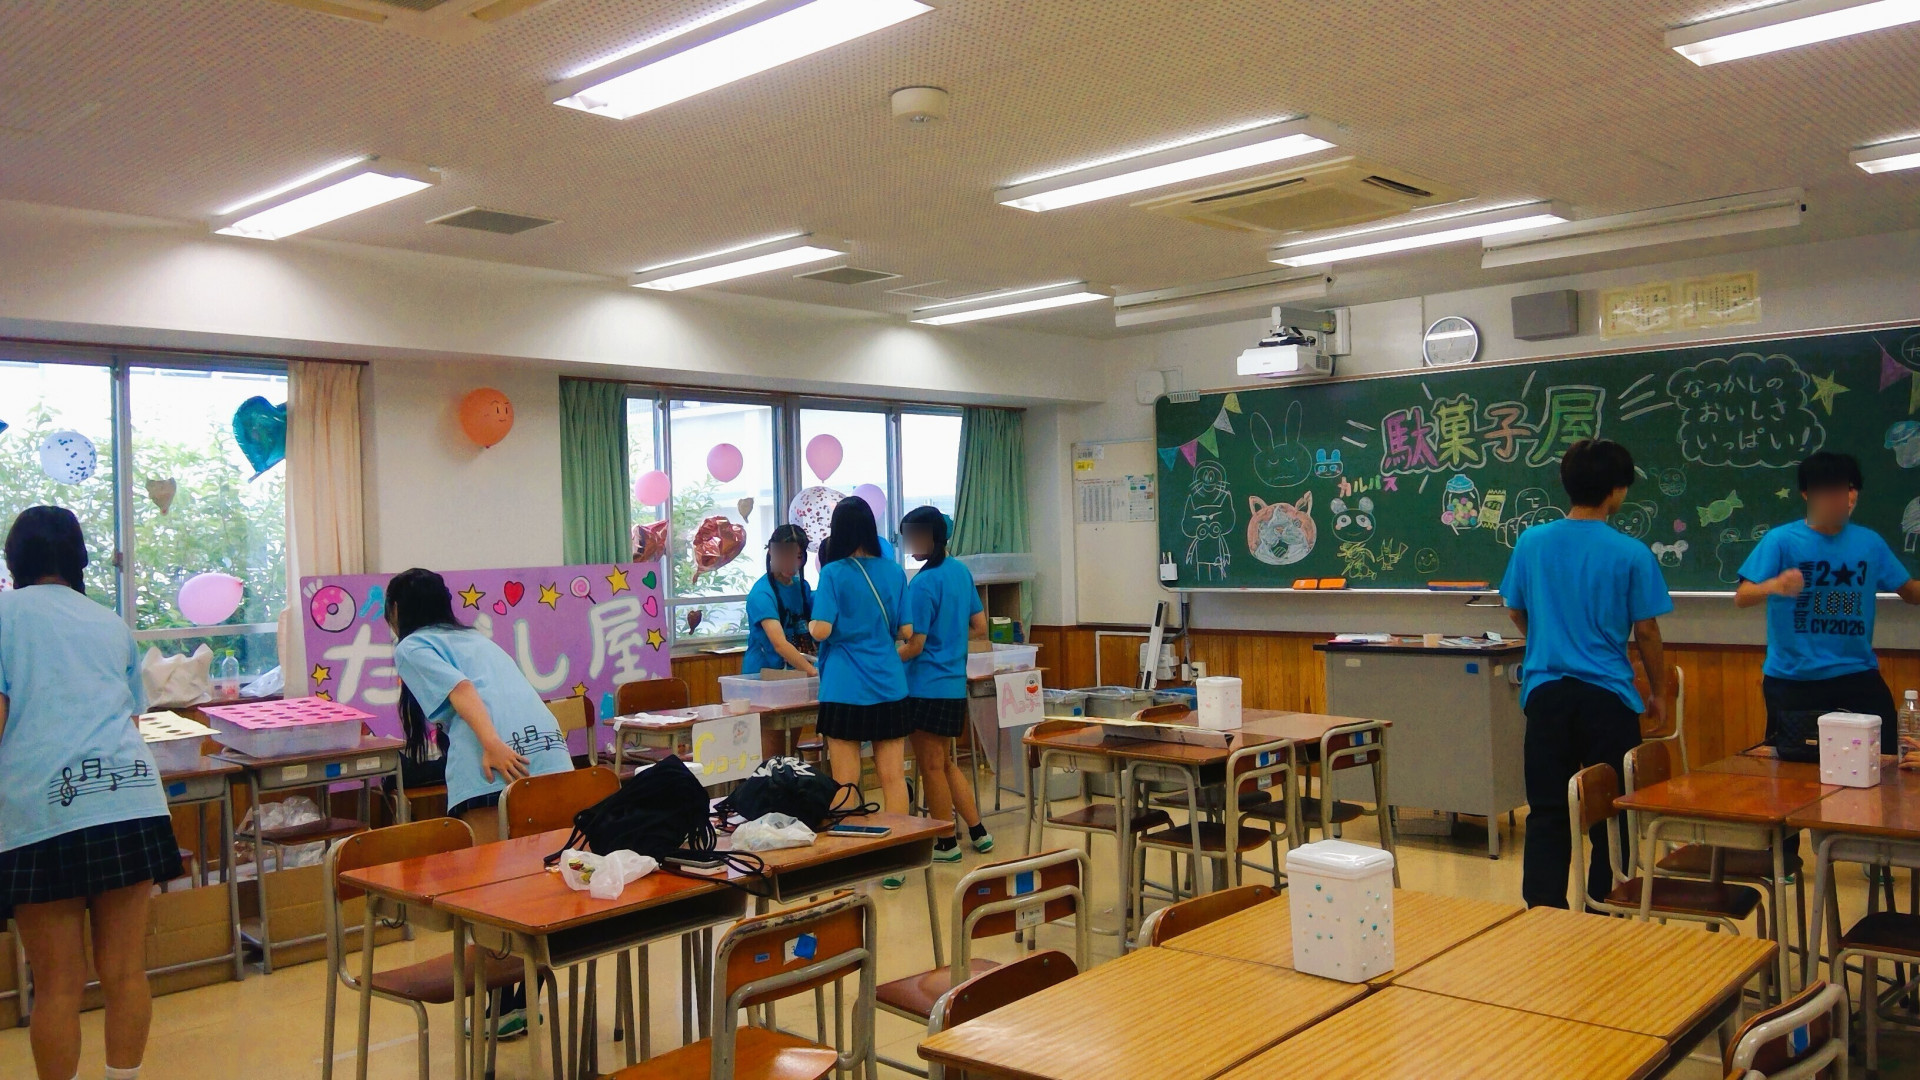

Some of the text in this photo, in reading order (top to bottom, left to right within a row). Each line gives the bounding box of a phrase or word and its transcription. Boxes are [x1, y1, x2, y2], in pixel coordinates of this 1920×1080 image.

[1699, 397, 1787, 423] おいしさ
[1383, 388, 1598, 472] 駄菓子屋
[1696, 426, 1811, 452] いっぱい!
[1810, 618, 1866, 636] CY2026
[322, 595, 649, 707] だし屋
